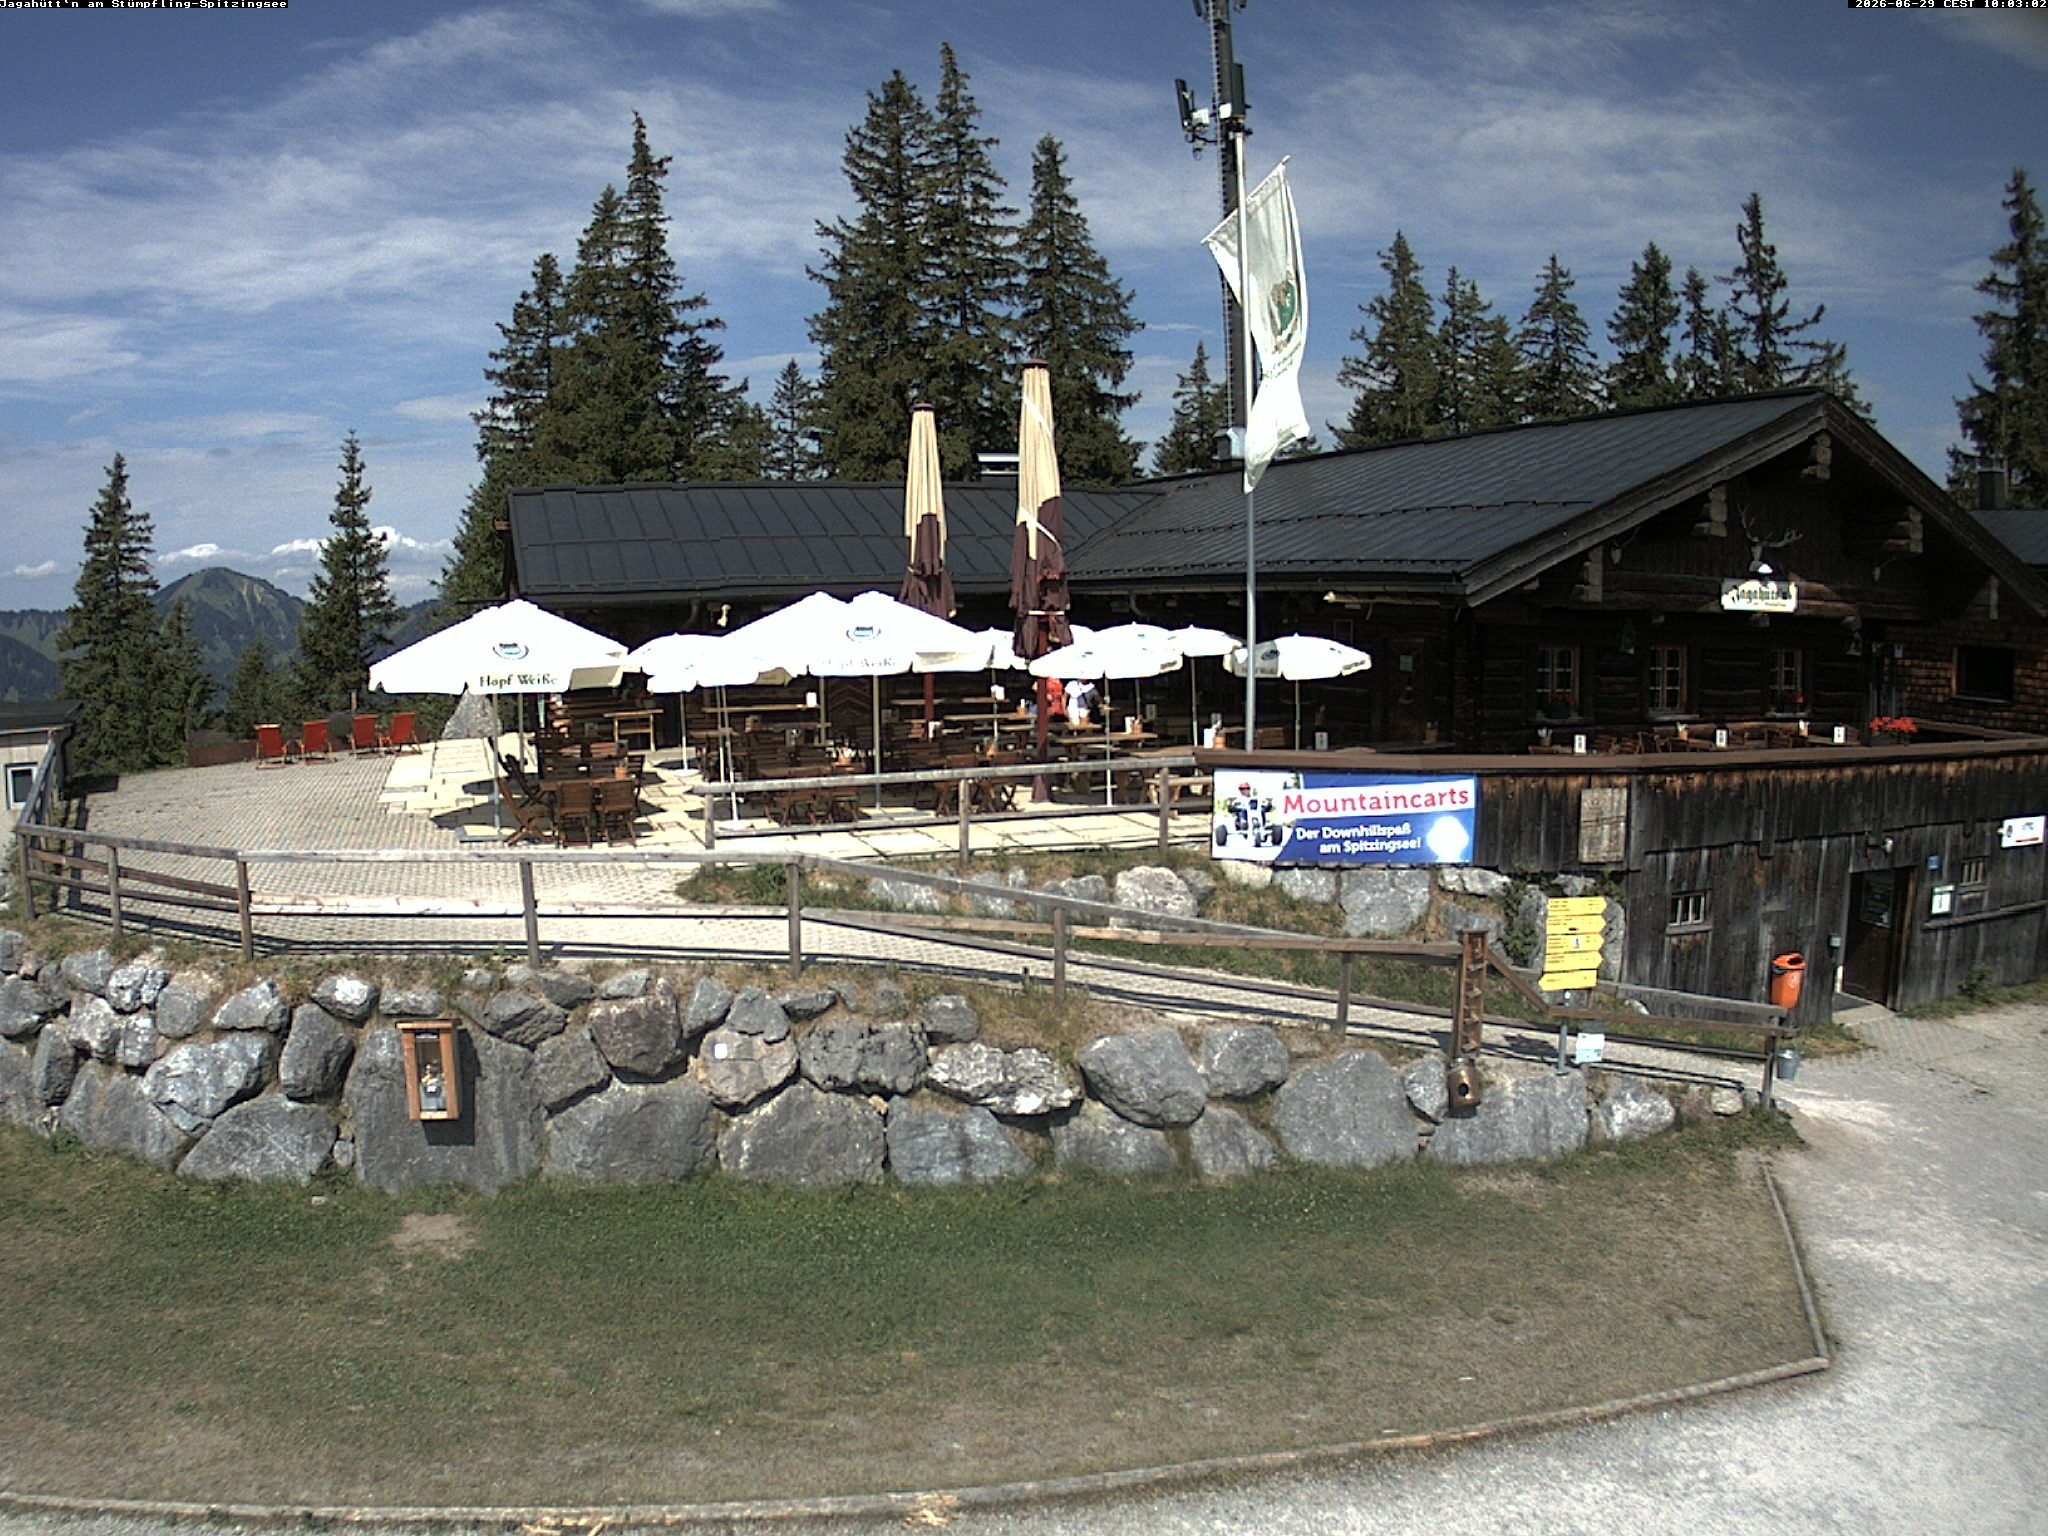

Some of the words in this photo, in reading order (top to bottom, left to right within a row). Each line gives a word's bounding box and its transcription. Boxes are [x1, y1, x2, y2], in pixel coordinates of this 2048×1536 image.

[480, 674, 513, 689] Hopf
[1283, 787, 1470, 815] Mountaincarts
[1295, 826, 1320, 840] Der
[1321, 822, 1412, 840] Downhillspaß
[1319, 843, 1341, 854] am
[1343, 837, 1421, 855] Spitzingsee!
